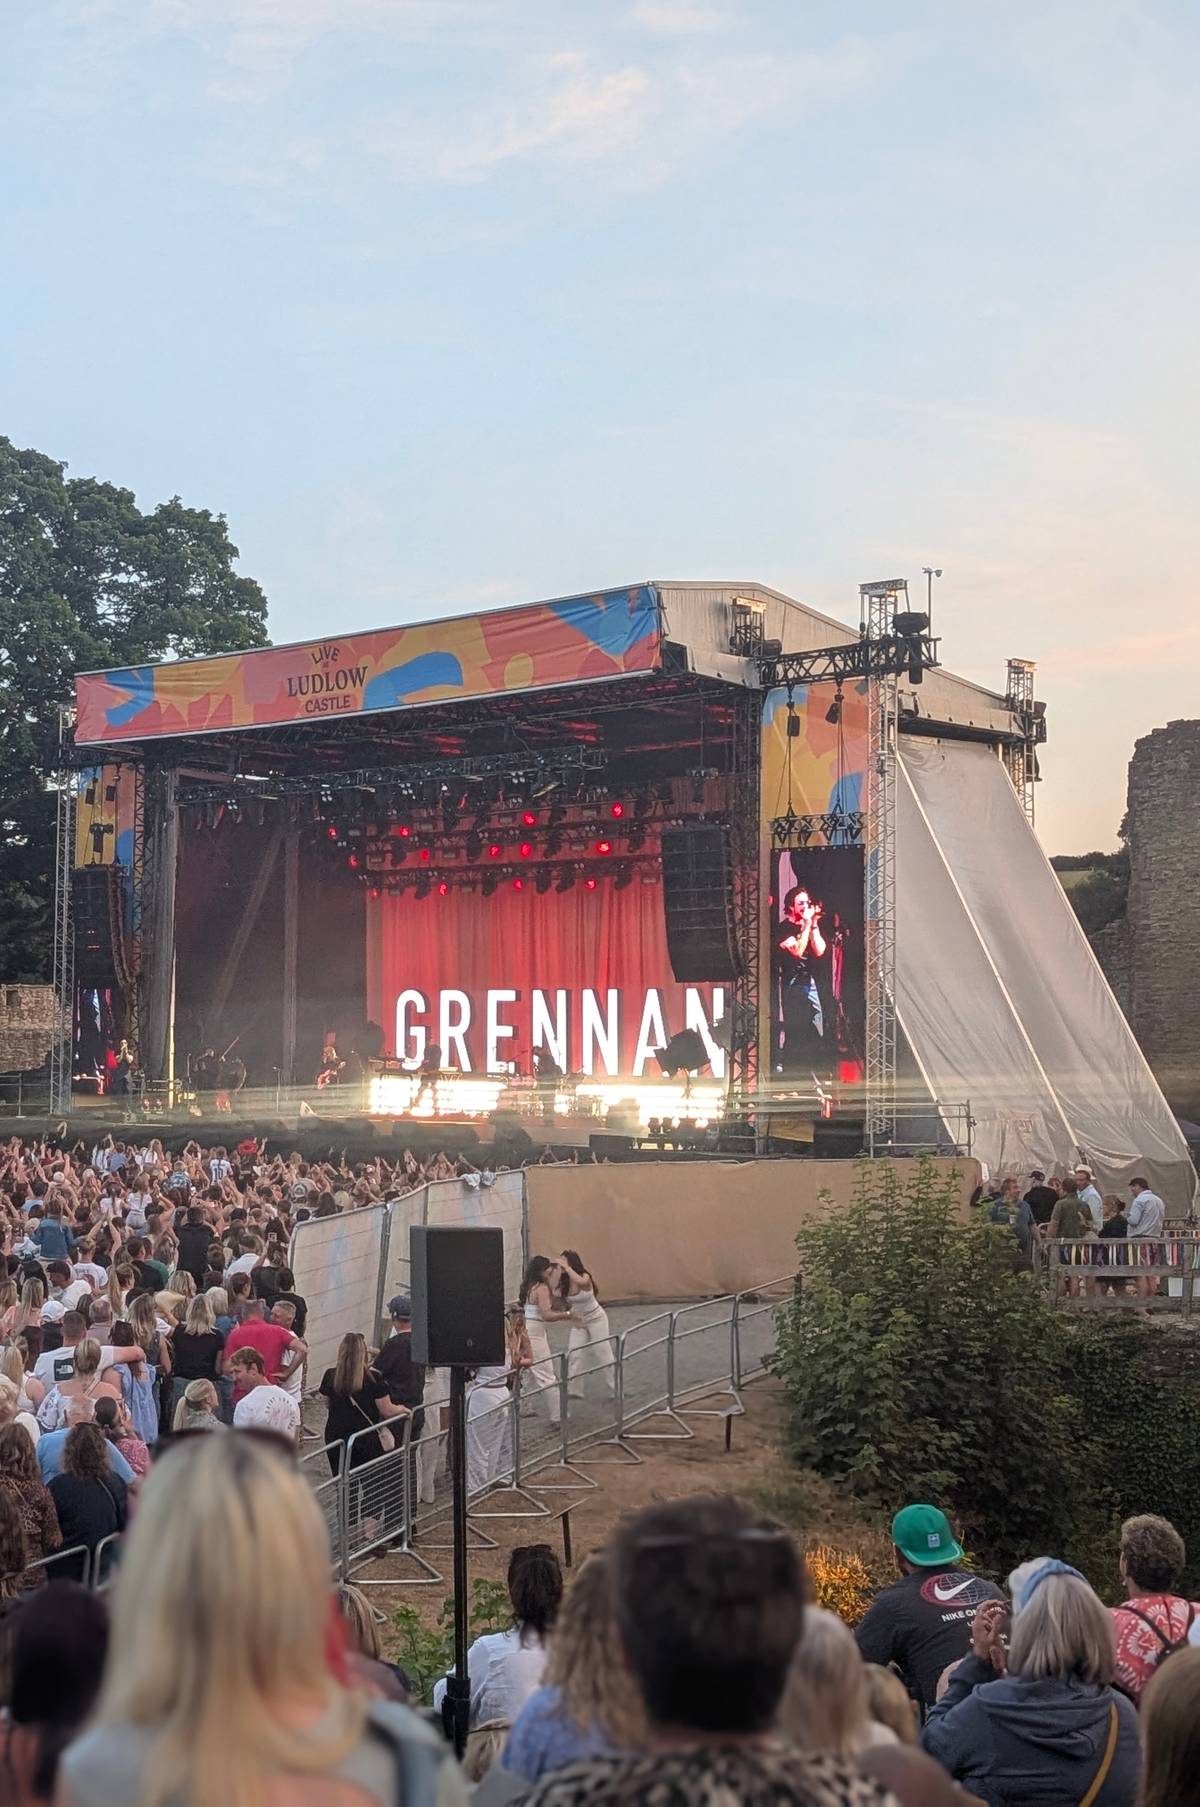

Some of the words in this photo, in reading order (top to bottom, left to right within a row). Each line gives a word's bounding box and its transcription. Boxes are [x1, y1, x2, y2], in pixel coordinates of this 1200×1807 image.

[311, 646, 340, 664] LIVE
[287, 666, 368, 697] LUDLOW
[305, 695, 351, 713] CASTLE
[395, 988, 726, 1079] GRENNAN
[941, 1610, 965, 1622] NIKE
